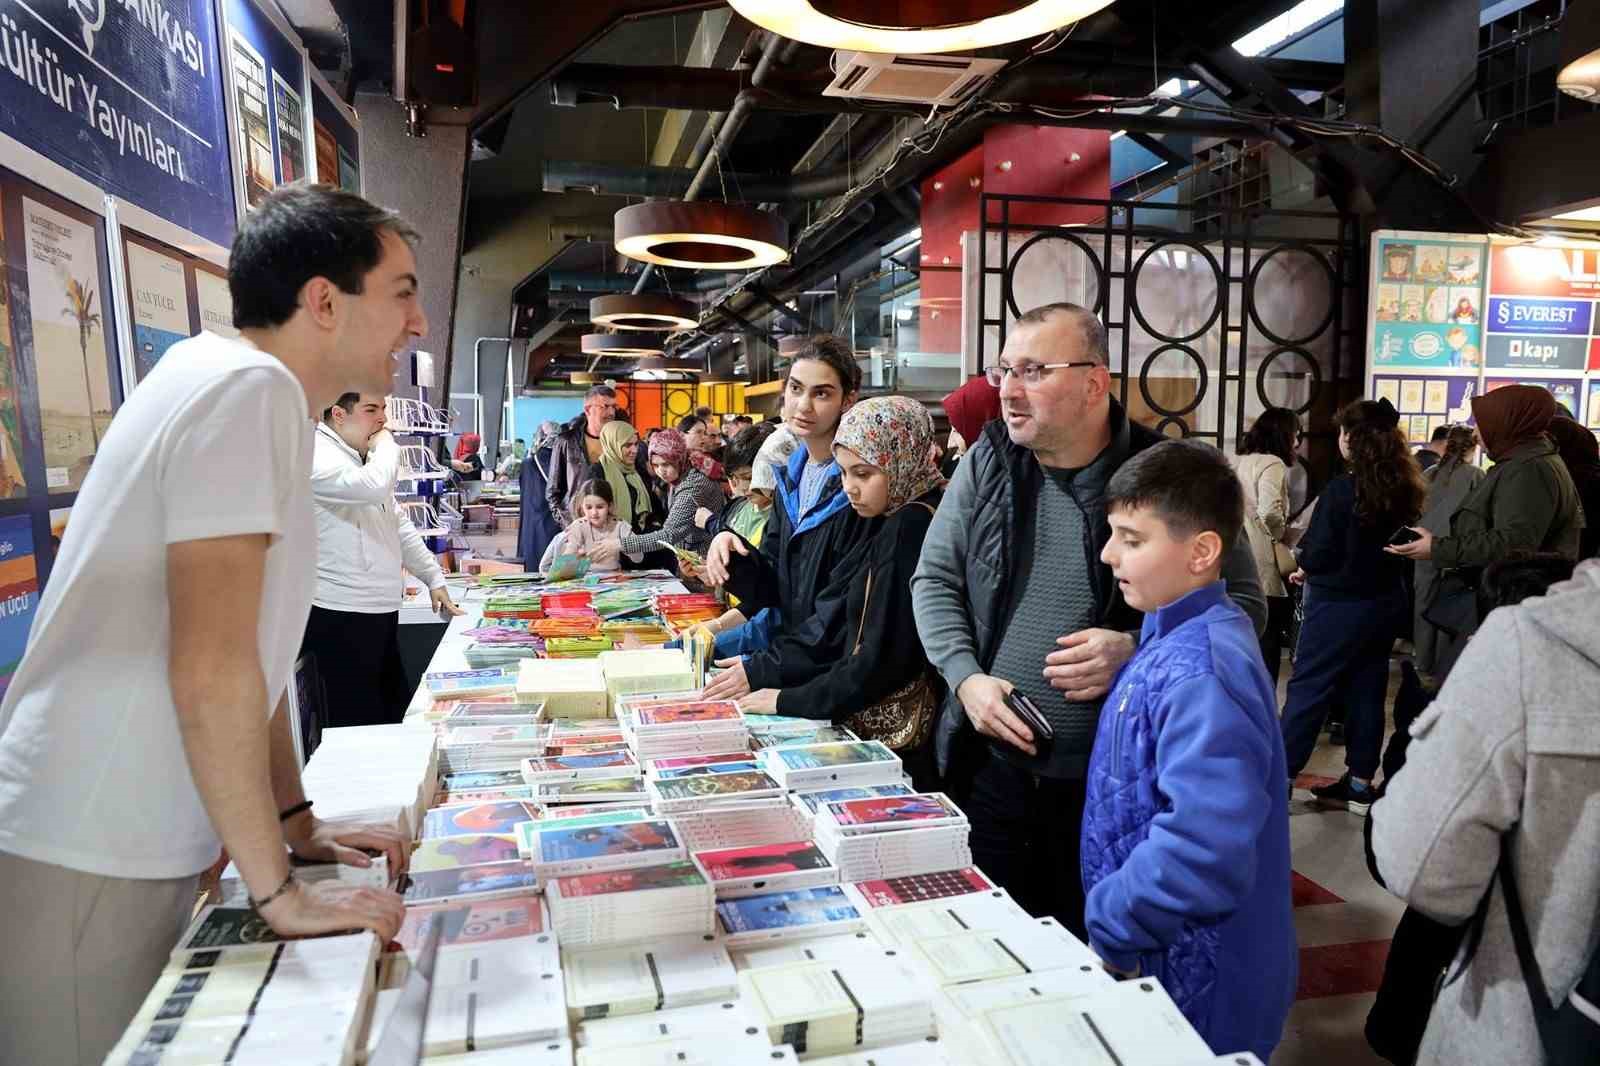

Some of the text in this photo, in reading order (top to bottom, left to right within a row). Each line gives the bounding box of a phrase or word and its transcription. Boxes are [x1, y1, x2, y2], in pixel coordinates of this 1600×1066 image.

[118, 0, 205, 77] ANKASI
[78, 73, 184, 182] Yayınları
[1513, 305, 1576, 323] EVEREST
[1524, 340, 1558, 362] kapı
